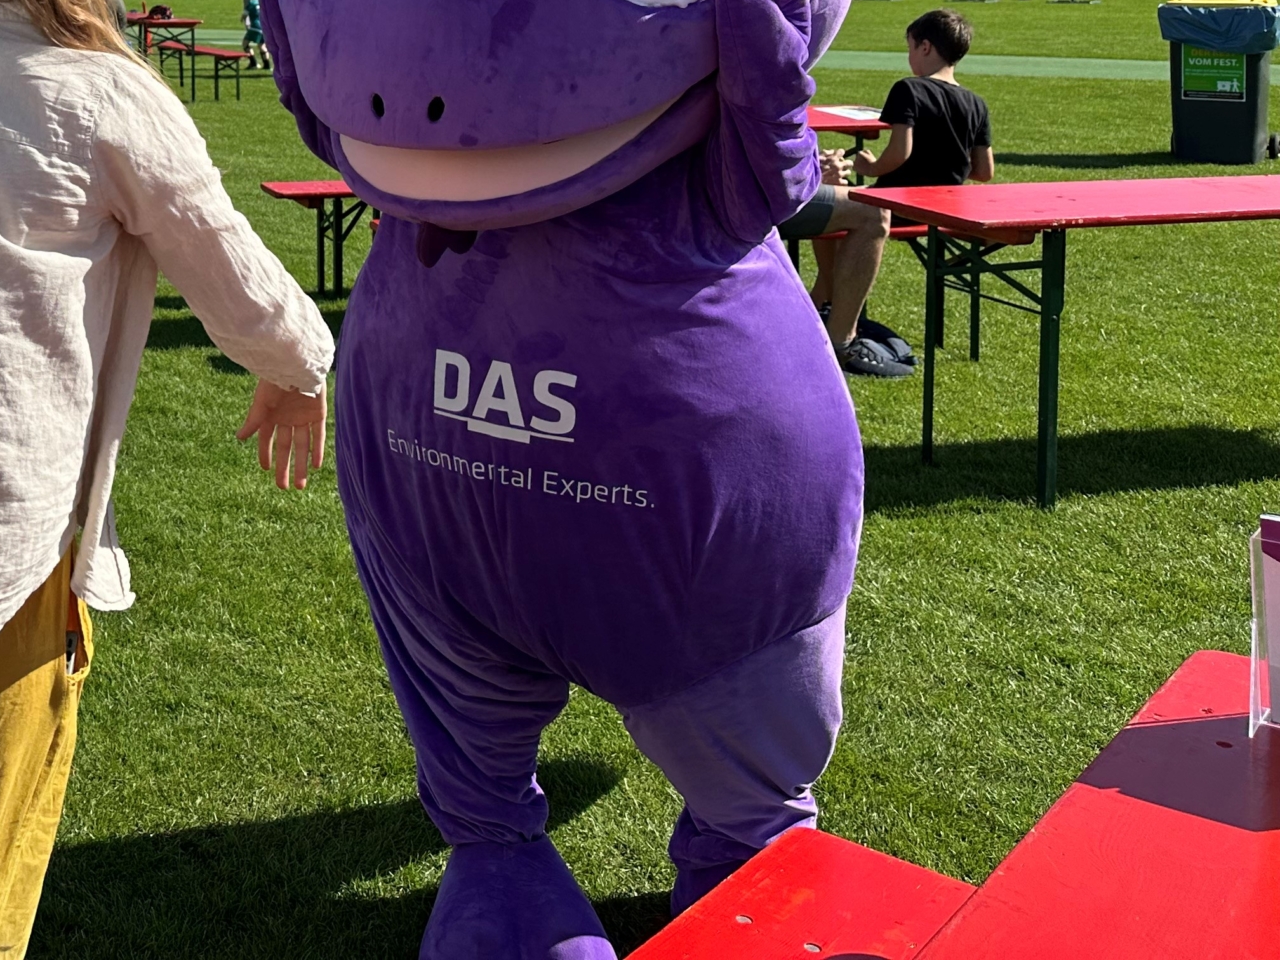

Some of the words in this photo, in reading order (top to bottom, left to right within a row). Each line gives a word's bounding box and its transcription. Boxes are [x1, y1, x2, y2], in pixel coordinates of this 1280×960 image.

[1188, 57, 1212, 65] VOM
[1213, 58, 1239, 66] FEST.
[433, 348, 578, 437] DAS
[542, 471, 656, 509] Experts.
